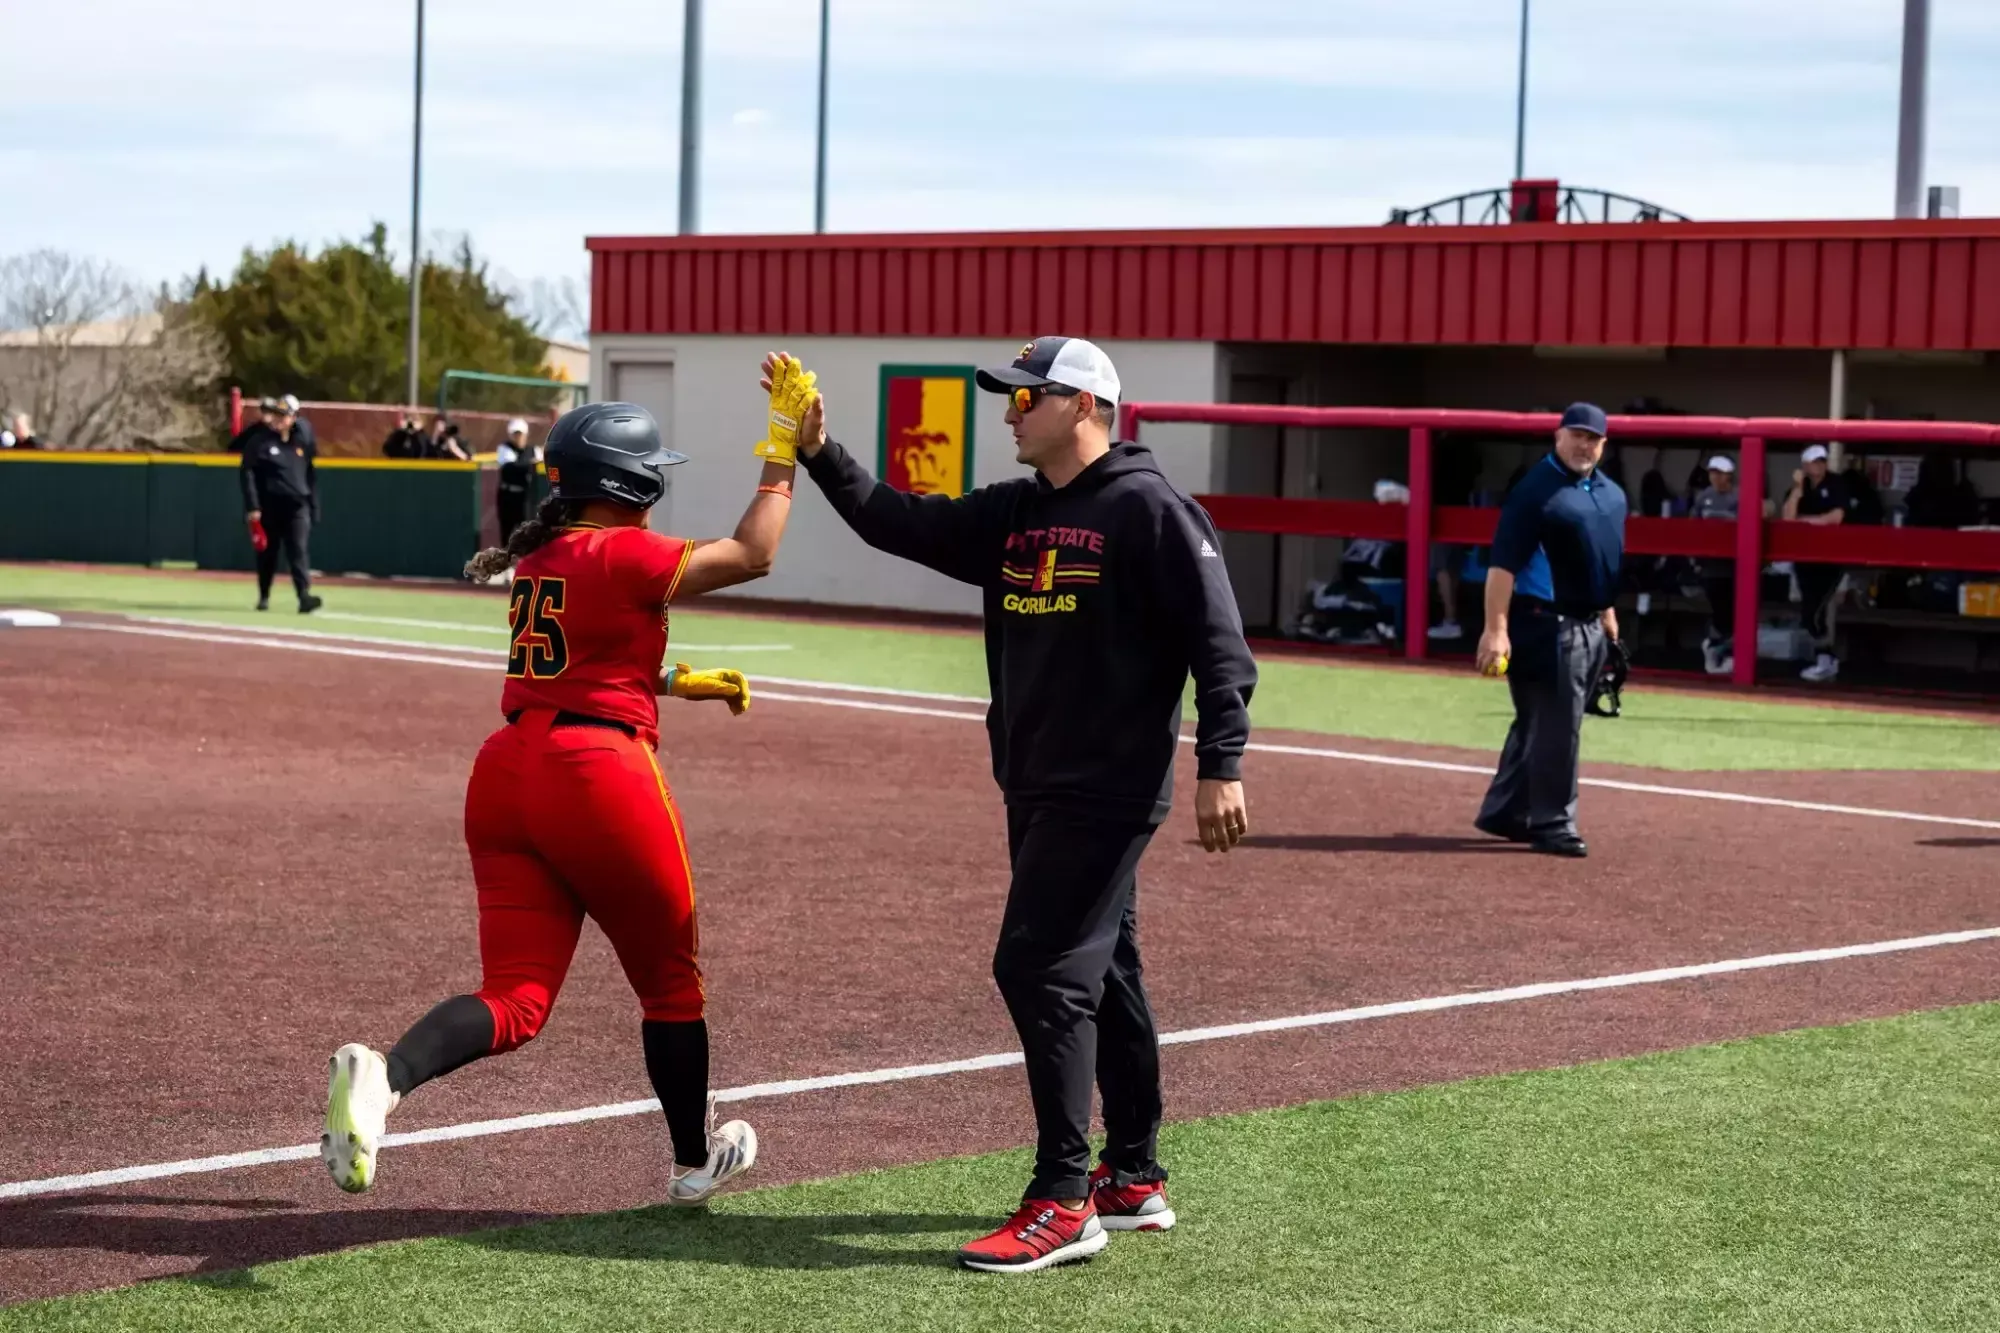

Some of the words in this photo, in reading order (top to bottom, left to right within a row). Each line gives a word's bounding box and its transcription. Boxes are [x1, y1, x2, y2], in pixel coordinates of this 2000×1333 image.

[1046, 527, 1105, 555] STATE
[1003, 594, 1077, 614] GORILLAS
[505, 576, 569, 679] 25
